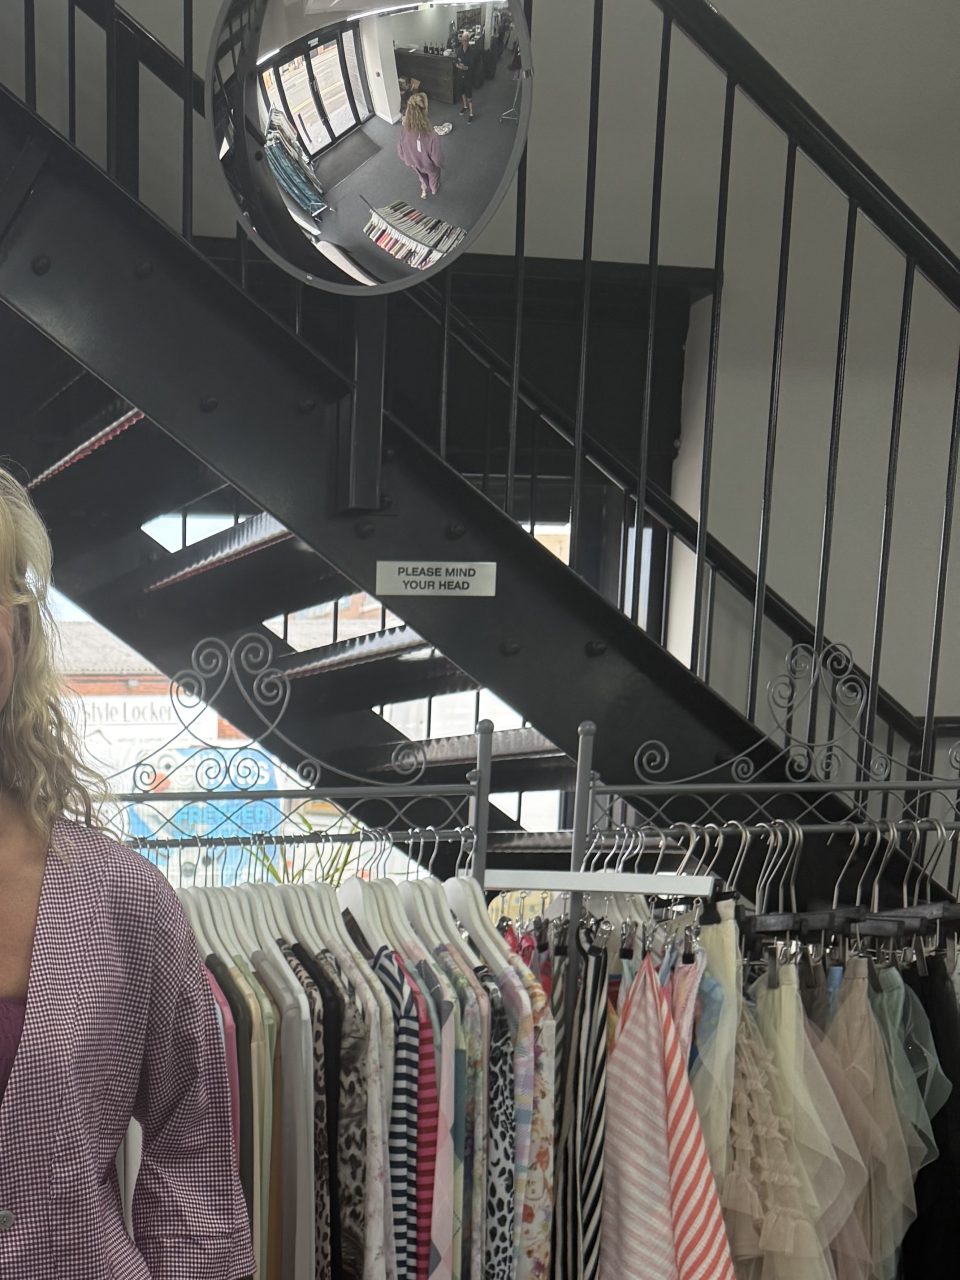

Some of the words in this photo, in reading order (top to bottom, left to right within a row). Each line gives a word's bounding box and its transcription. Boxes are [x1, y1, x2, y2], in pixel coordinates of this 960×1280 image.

[397, 567, 442, 577] PLEASE
[445, 568, 476, 577] MIND
[402, 580, 436, 590] YOUR
[439, 581, 470, 590] HEAD
[123, 701, 172, 722] Locker
